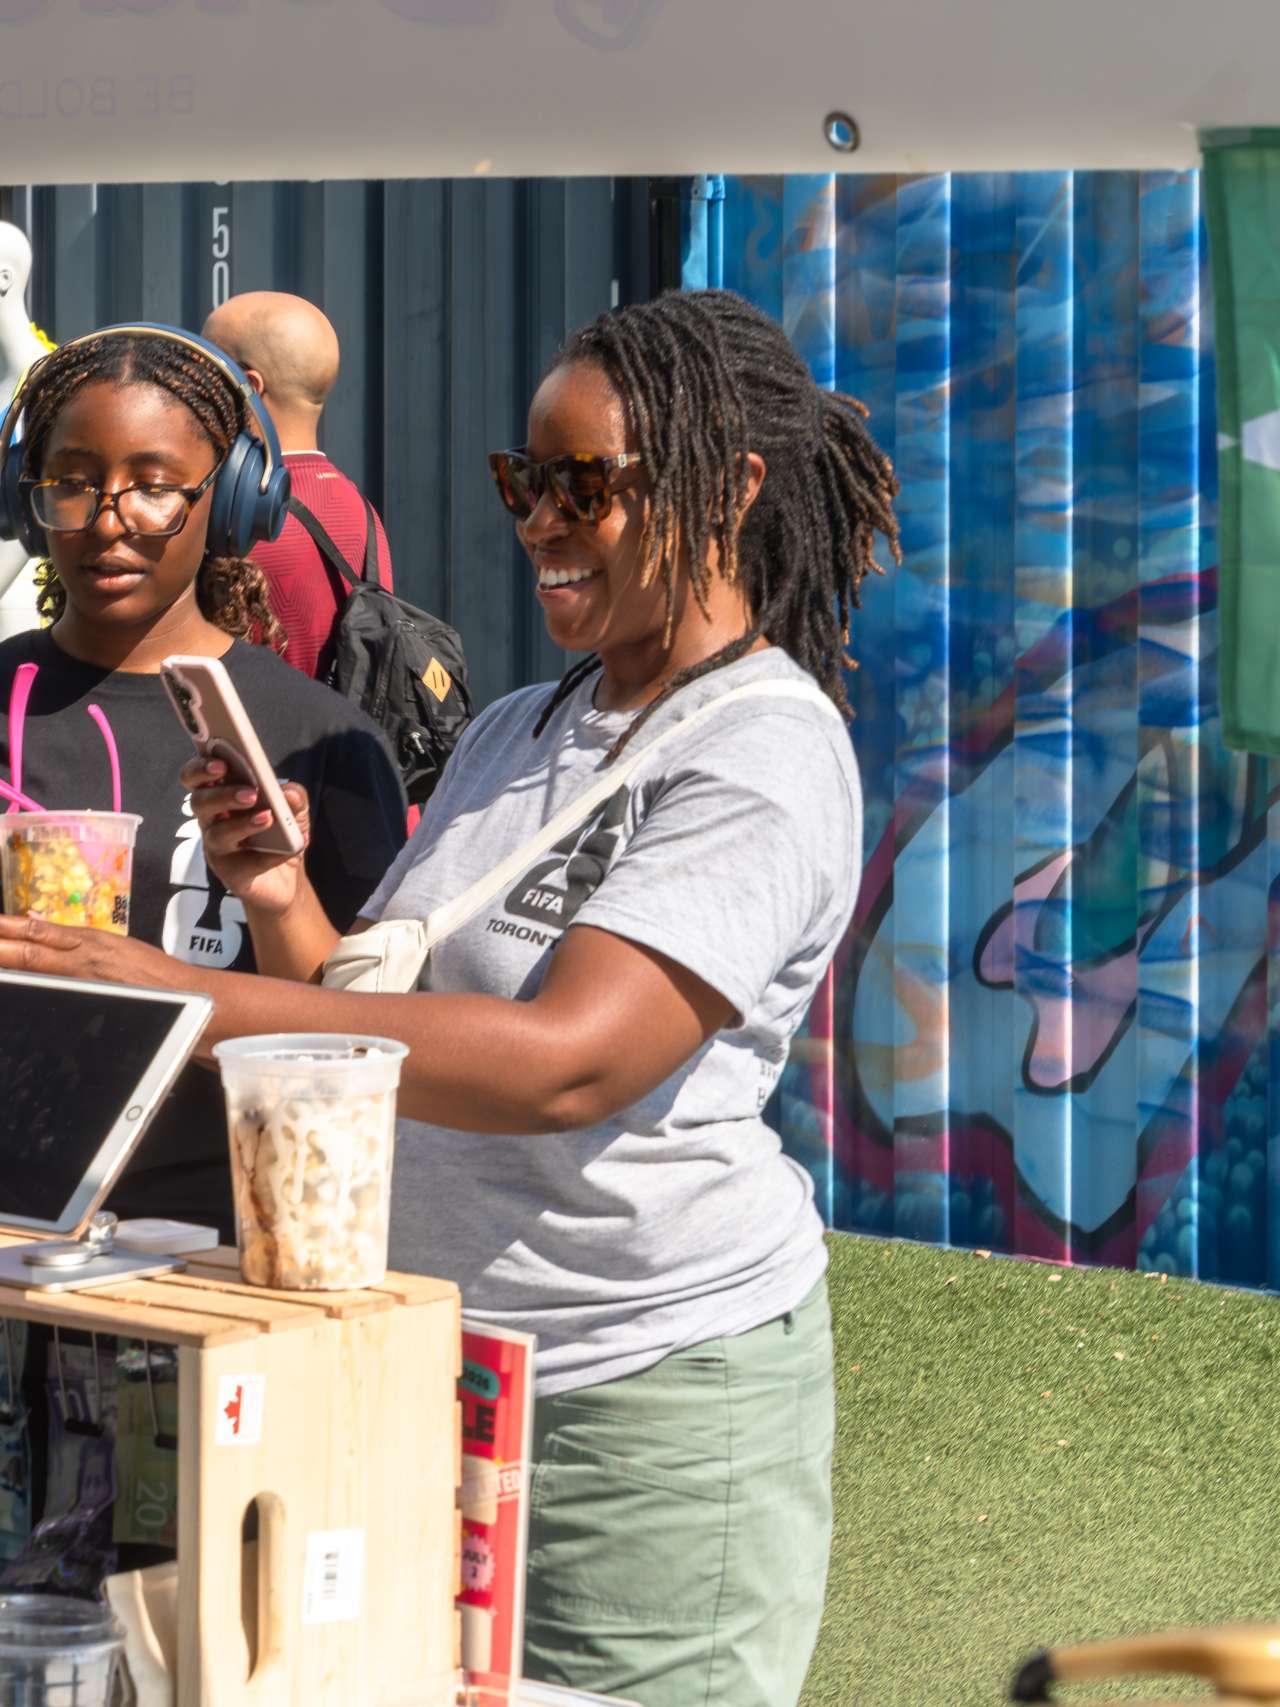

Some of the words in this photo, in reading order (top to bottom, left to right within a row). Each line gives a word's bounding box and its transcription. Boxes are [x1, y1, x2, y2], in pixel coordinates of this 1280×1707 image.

[520, 888, 564, 915] FIFA
[189, 934, 224, 955] FIFA
[485, 918, 561, 950] TORONT
[461, 1401, 496, 1442] LE
